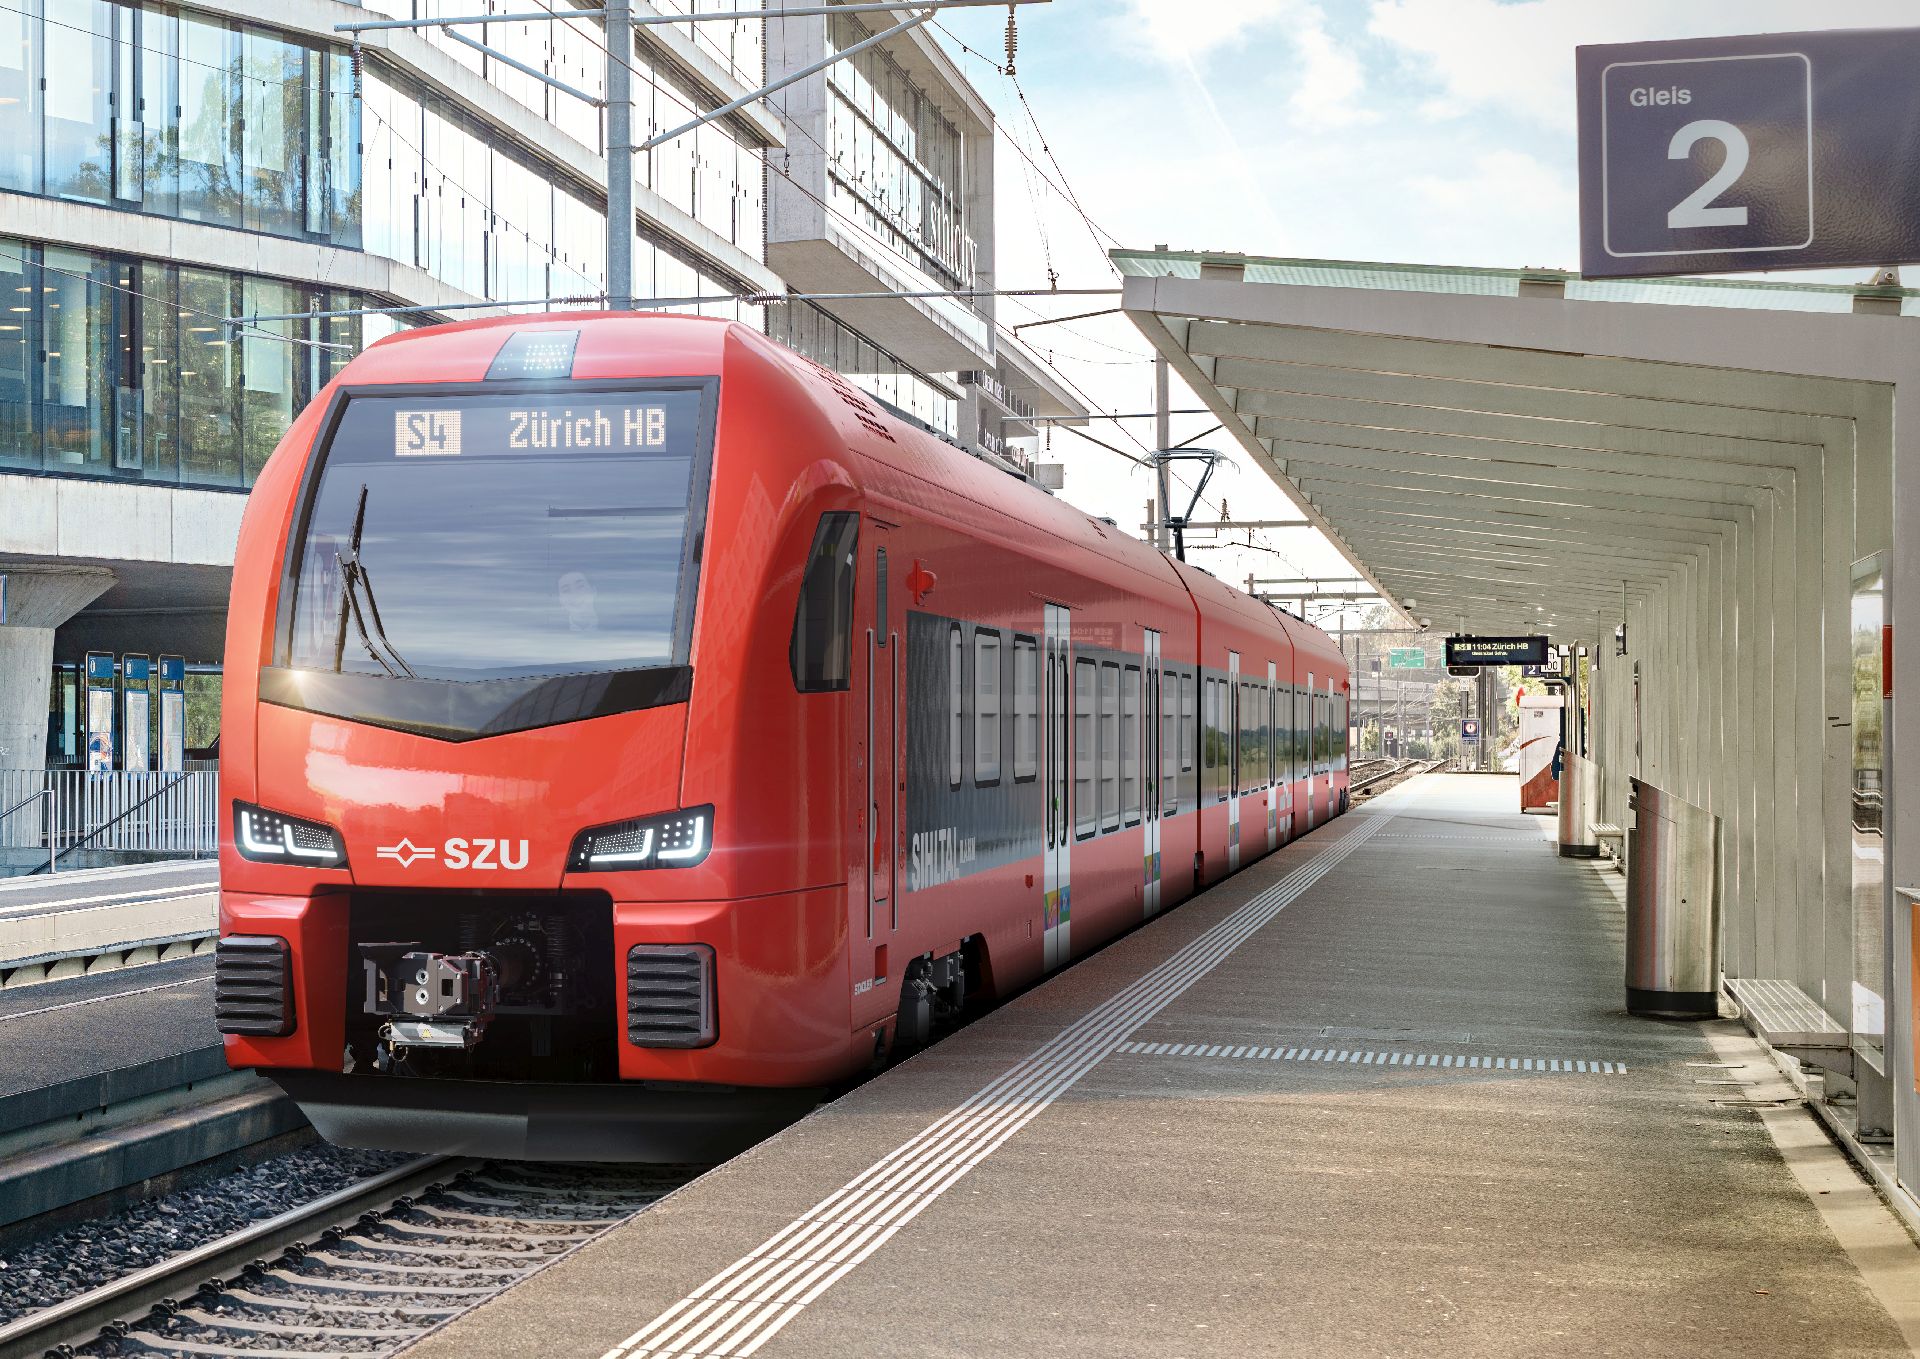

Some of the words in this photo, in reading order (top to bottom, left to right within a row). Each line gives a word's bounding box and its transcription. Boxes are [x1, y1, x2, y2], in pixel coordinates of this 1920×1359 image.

[1629, 86, 1692, 107] Gleis
[1667, 119, 1750, 229] 2
[407, 413, 448, 450] S4
[510, 409, 611, 449] Zürich
[624, 408, 665, 446] HB
[444, 837, 529, 870] SZU
[912, 827, 960, 892] SIHLTAL
